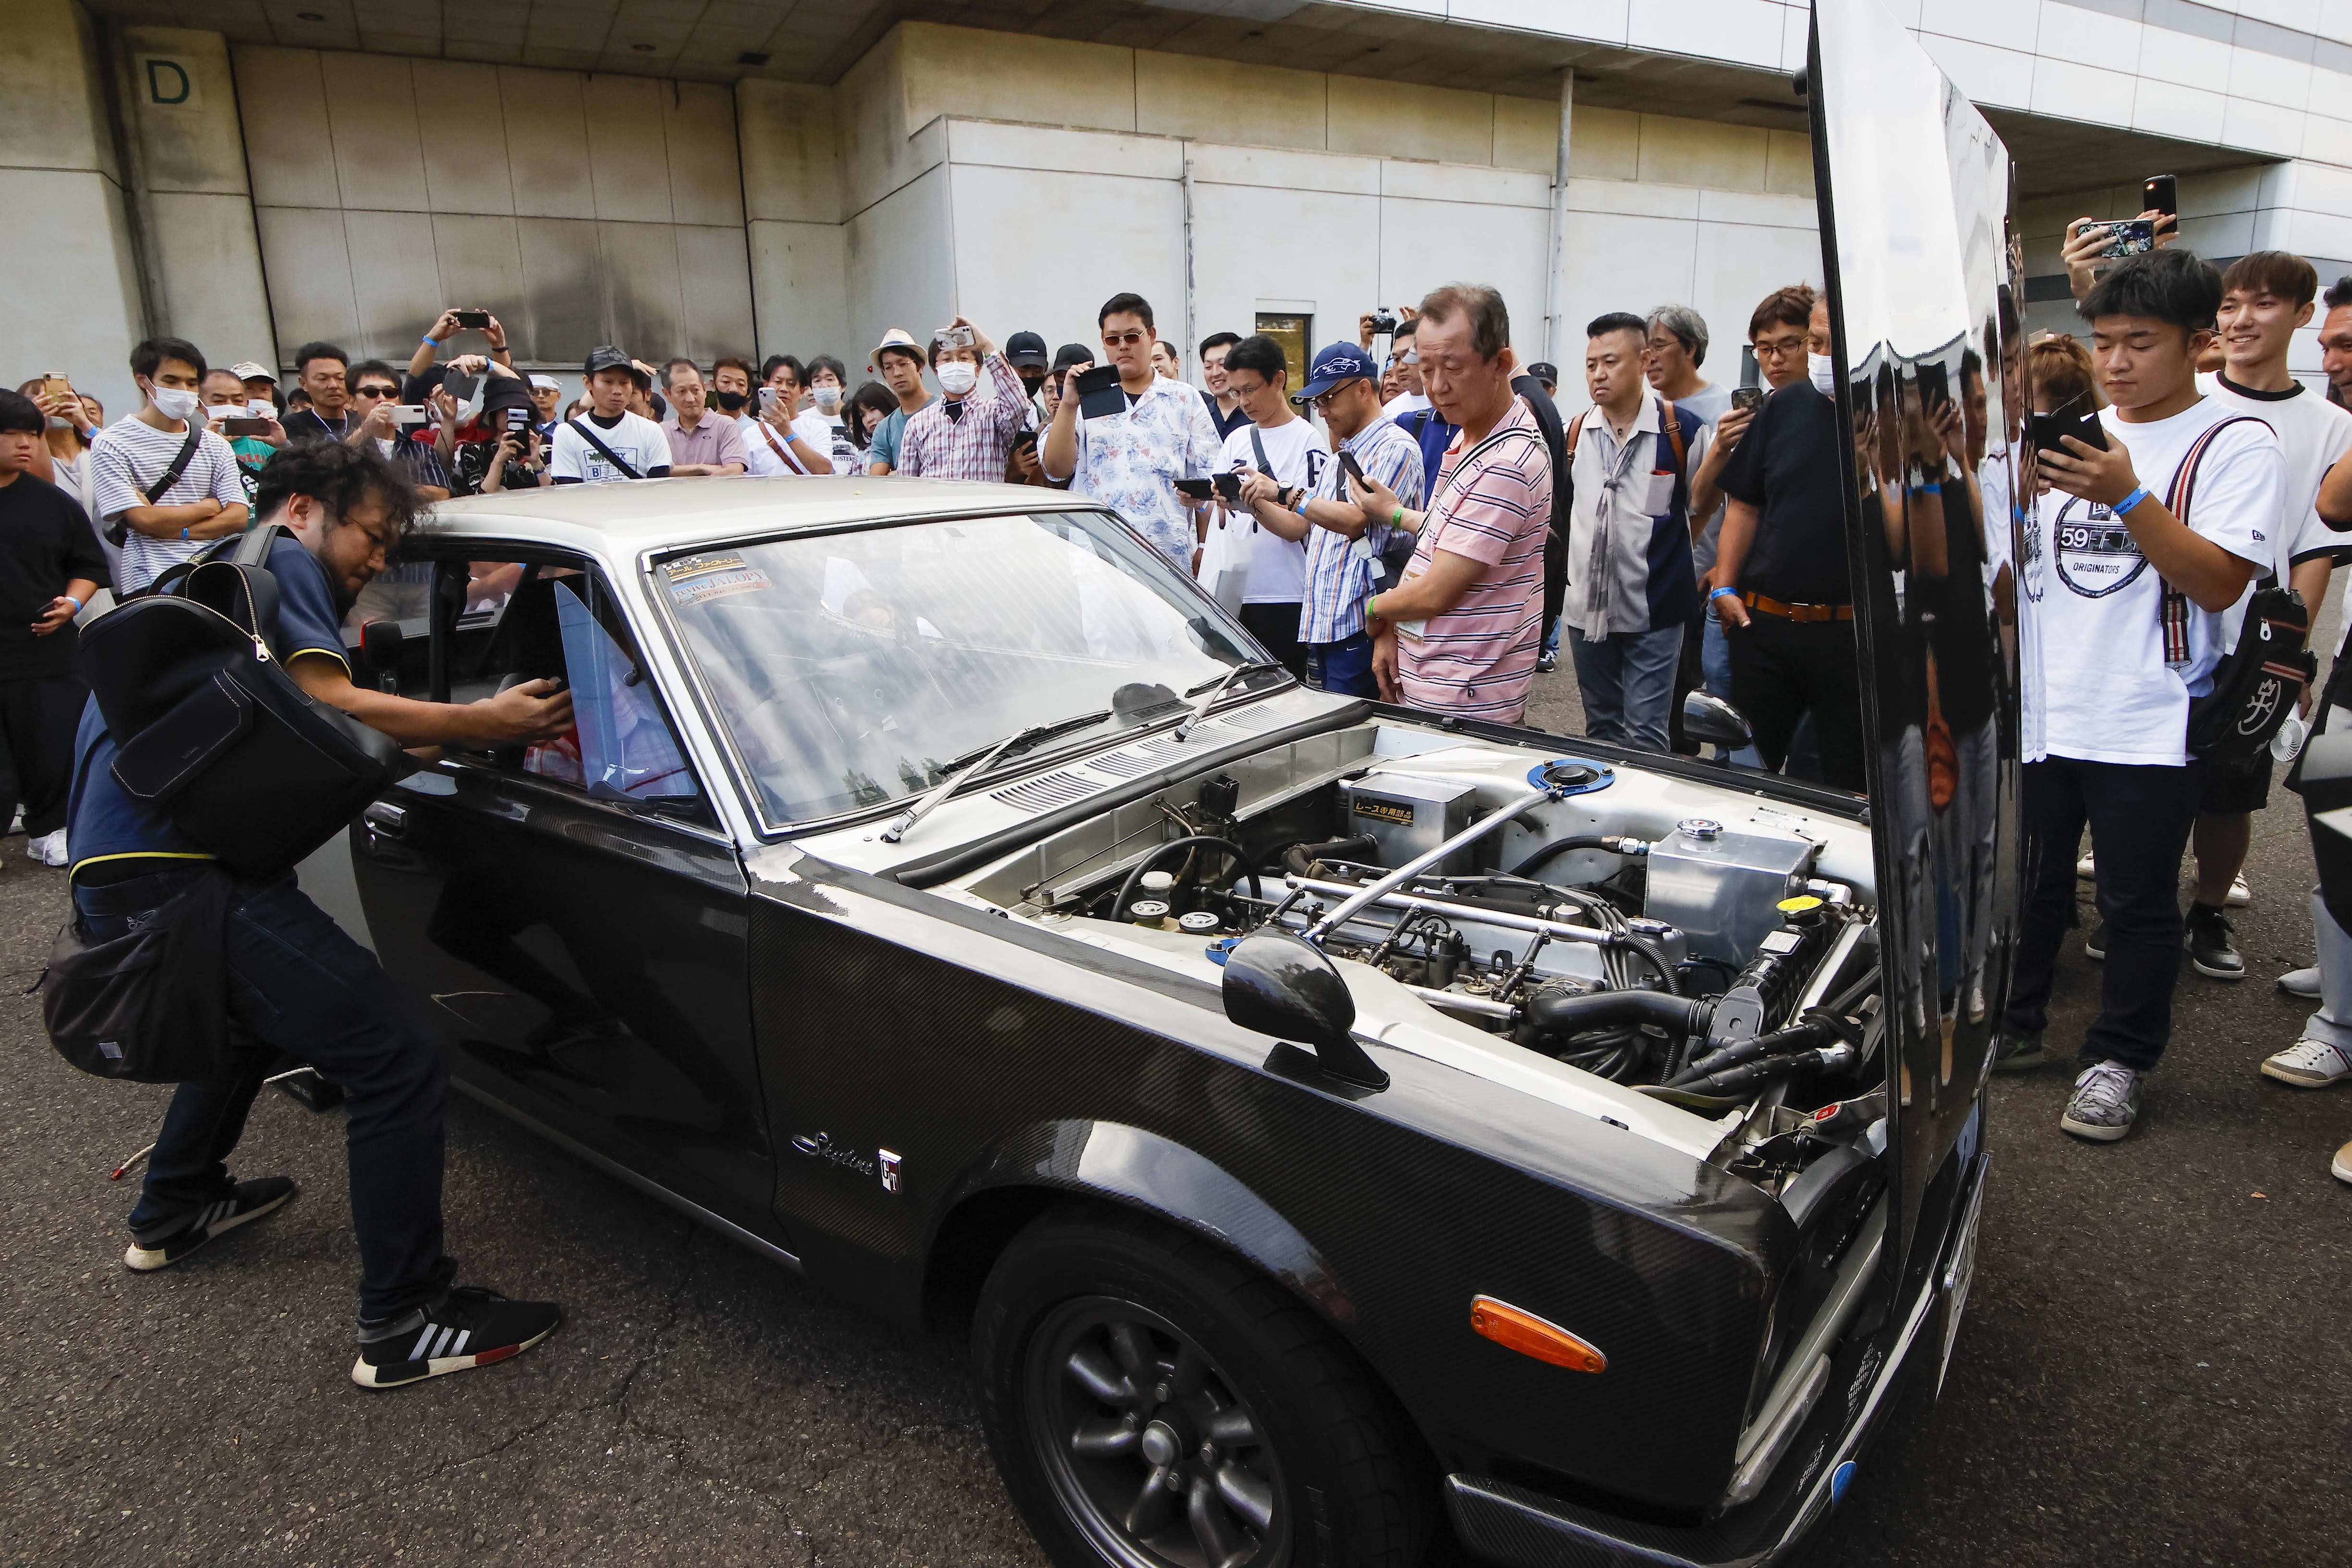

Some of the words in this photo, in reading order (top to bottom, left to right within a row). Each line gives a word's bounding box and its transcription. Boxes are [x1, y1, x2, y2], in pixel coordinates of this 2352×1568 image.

[146, 60, 190, 104] D
[2073, 562, 2120, 573] ORIGINATORS
[675, 583, 707, 596] revive
[709, 571, 764, 588] JALOPY
[1398, 629, 1418, 641] PARTICIPANT
[1356, 802, 1412, 819] レース専用部品
[881, 1159, 897, 1191] GT
